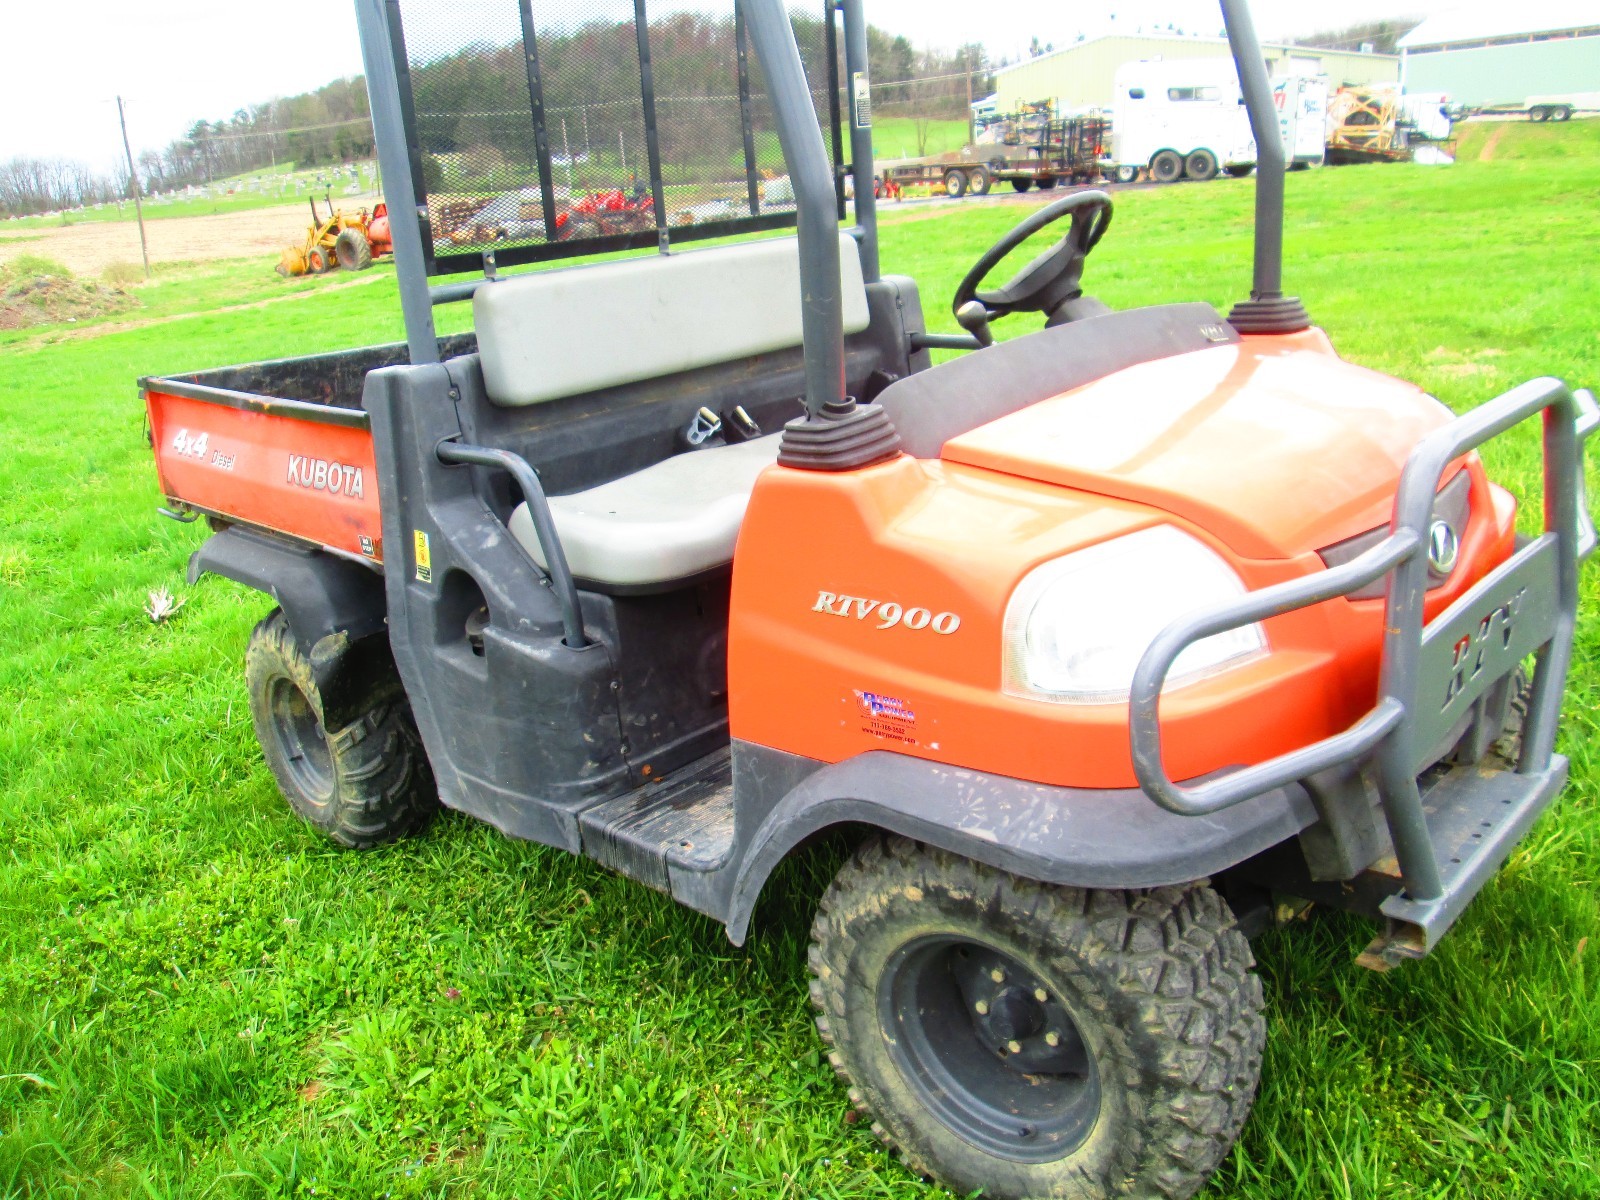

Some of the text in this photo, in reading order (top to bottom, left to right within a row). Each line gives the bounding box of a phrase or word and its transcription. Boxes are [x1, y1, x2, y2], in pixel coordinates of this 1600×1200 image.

[173, 428, 236, 471] 4x4 Diesel
[286, 453, 364, 499] KUBOTA
[811, 590, 961, 635] RTV900
[1440, 586, 1527, 714] RTV
[871, 701, 915, 720] POWER
